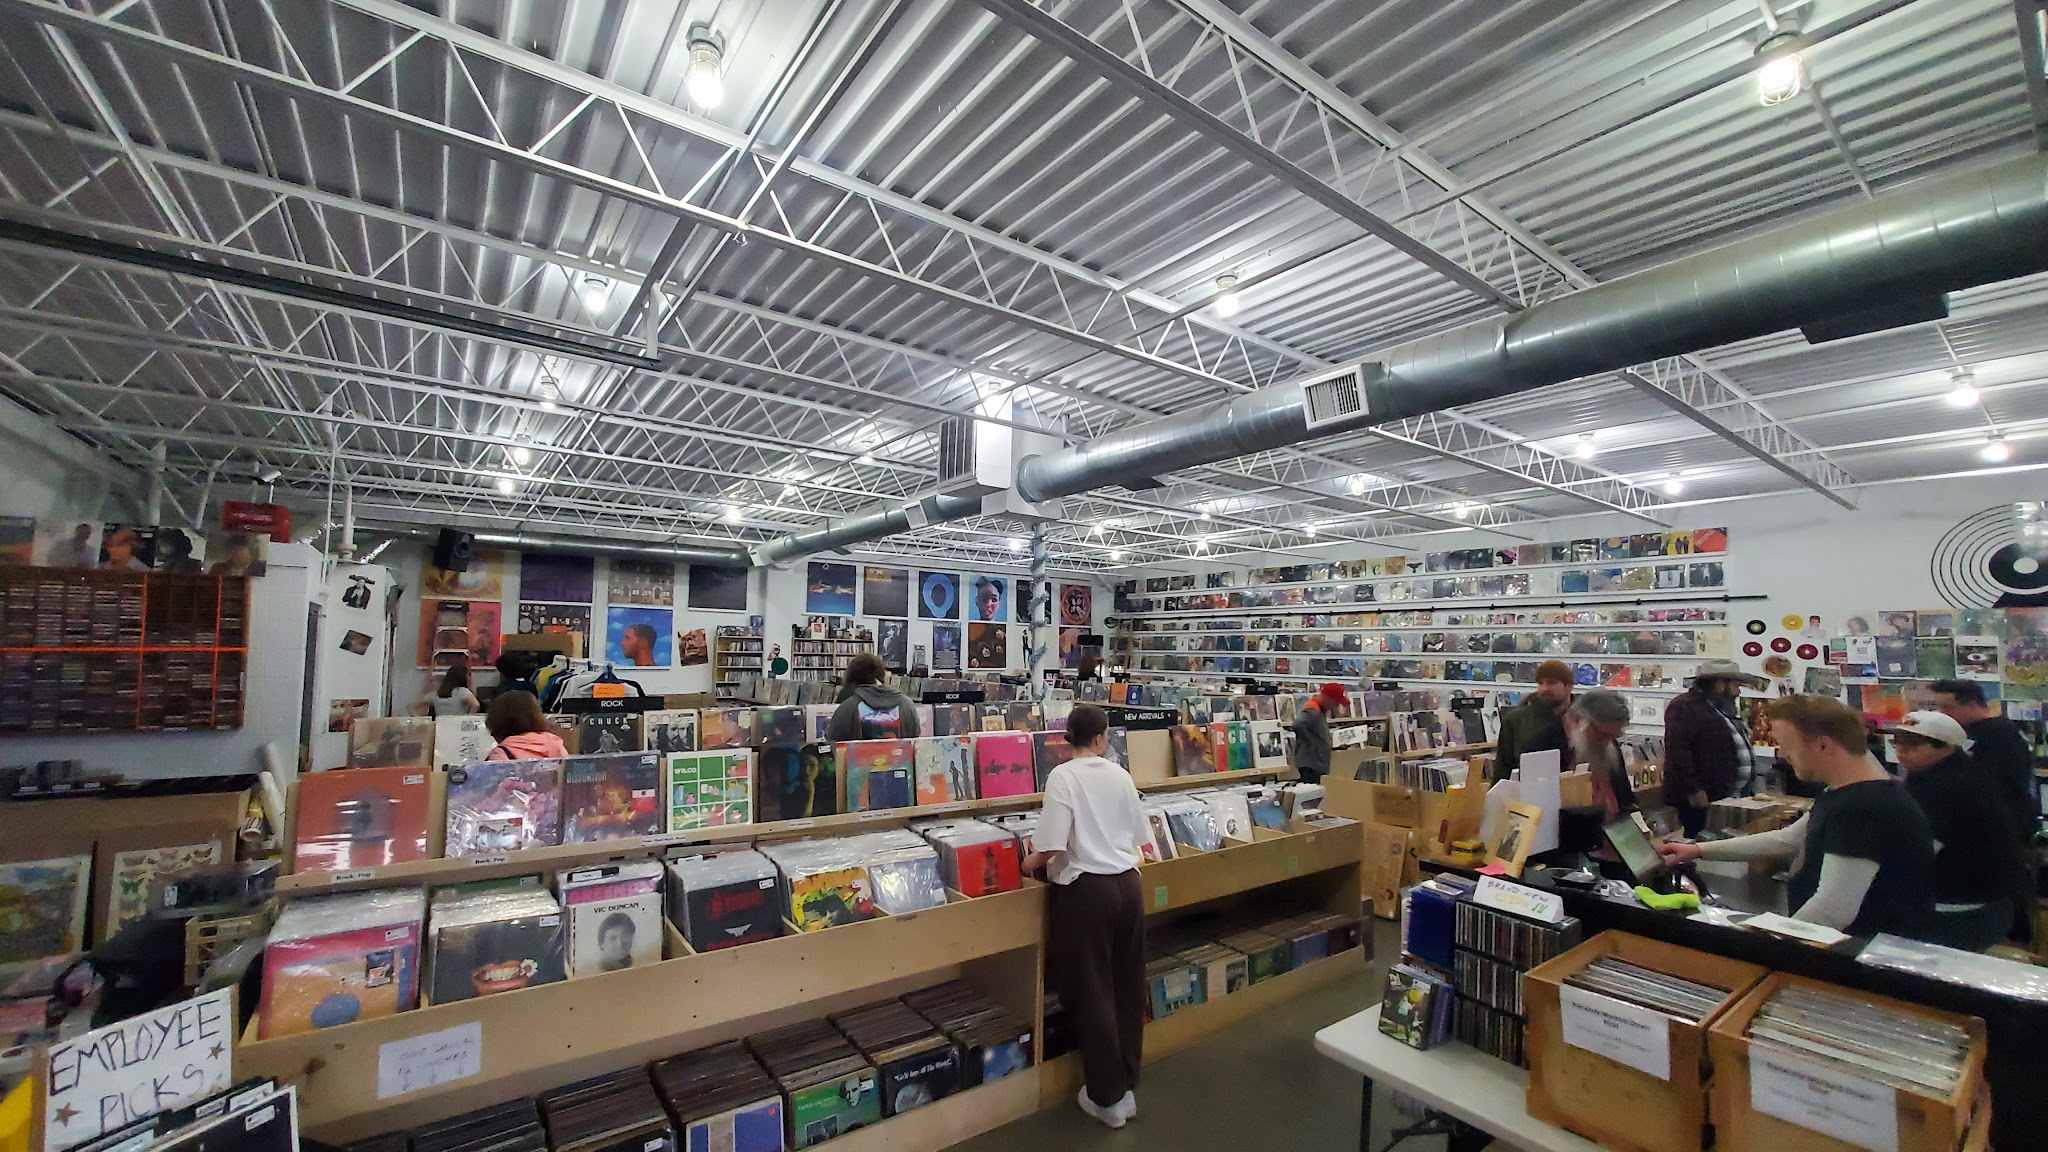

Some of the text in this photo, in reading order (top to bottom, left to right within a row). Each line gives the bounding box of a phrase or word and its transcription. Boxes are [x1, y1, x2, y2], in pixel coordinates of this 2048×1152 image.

[600, 699, 624, 708] ROCK
[589, 717, 629, 726] CHUCK
[1123, 711, 1165, 721] NEW ARRIVALS
[673, 766, 697, 775] WILCO
[1487, 880, 1549, 903] BRAND NEW
[593, 902, 639, 914] VIC DUNCAN
[49, 999, 221, 1097] EMPLOYEE
[400, 1047, 428, 1062] ONE
[99, 1063, 206, 1134] PICKS
